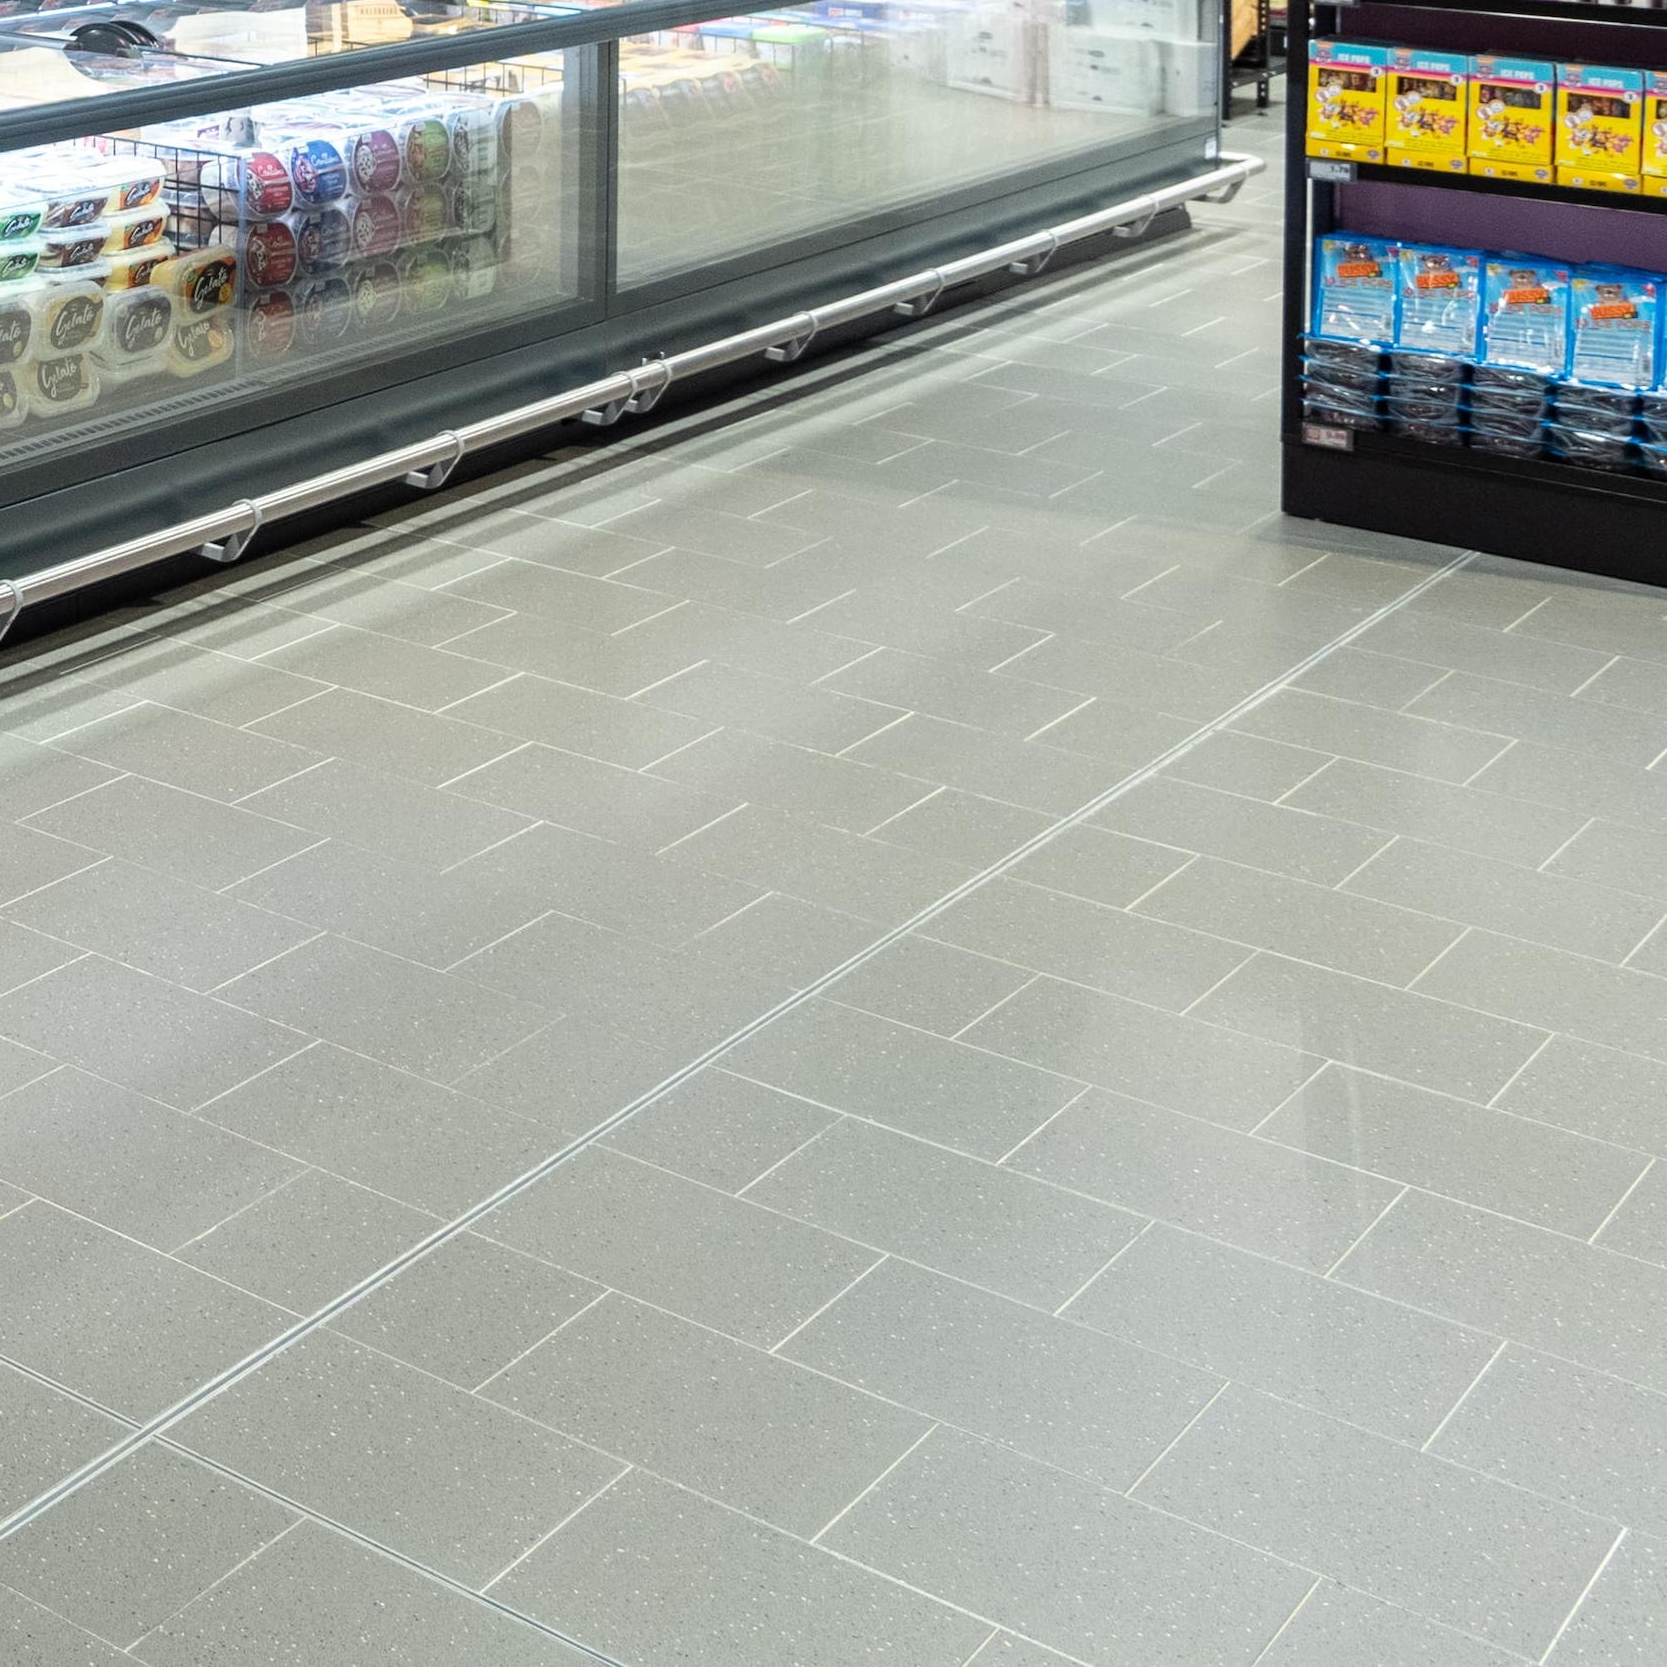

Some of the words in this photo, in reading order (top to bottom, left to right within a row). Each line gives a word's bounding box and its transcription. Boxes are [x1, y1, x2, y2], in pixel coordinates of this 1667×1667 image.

[193, 269, 228, 309] Gelato
[55, 307, 95, 344] Gelato
[125, 307, 163, 344] Gelato
[176, 320, 210, 358] Gelato
[41, 358, 77, 396] Gelato
